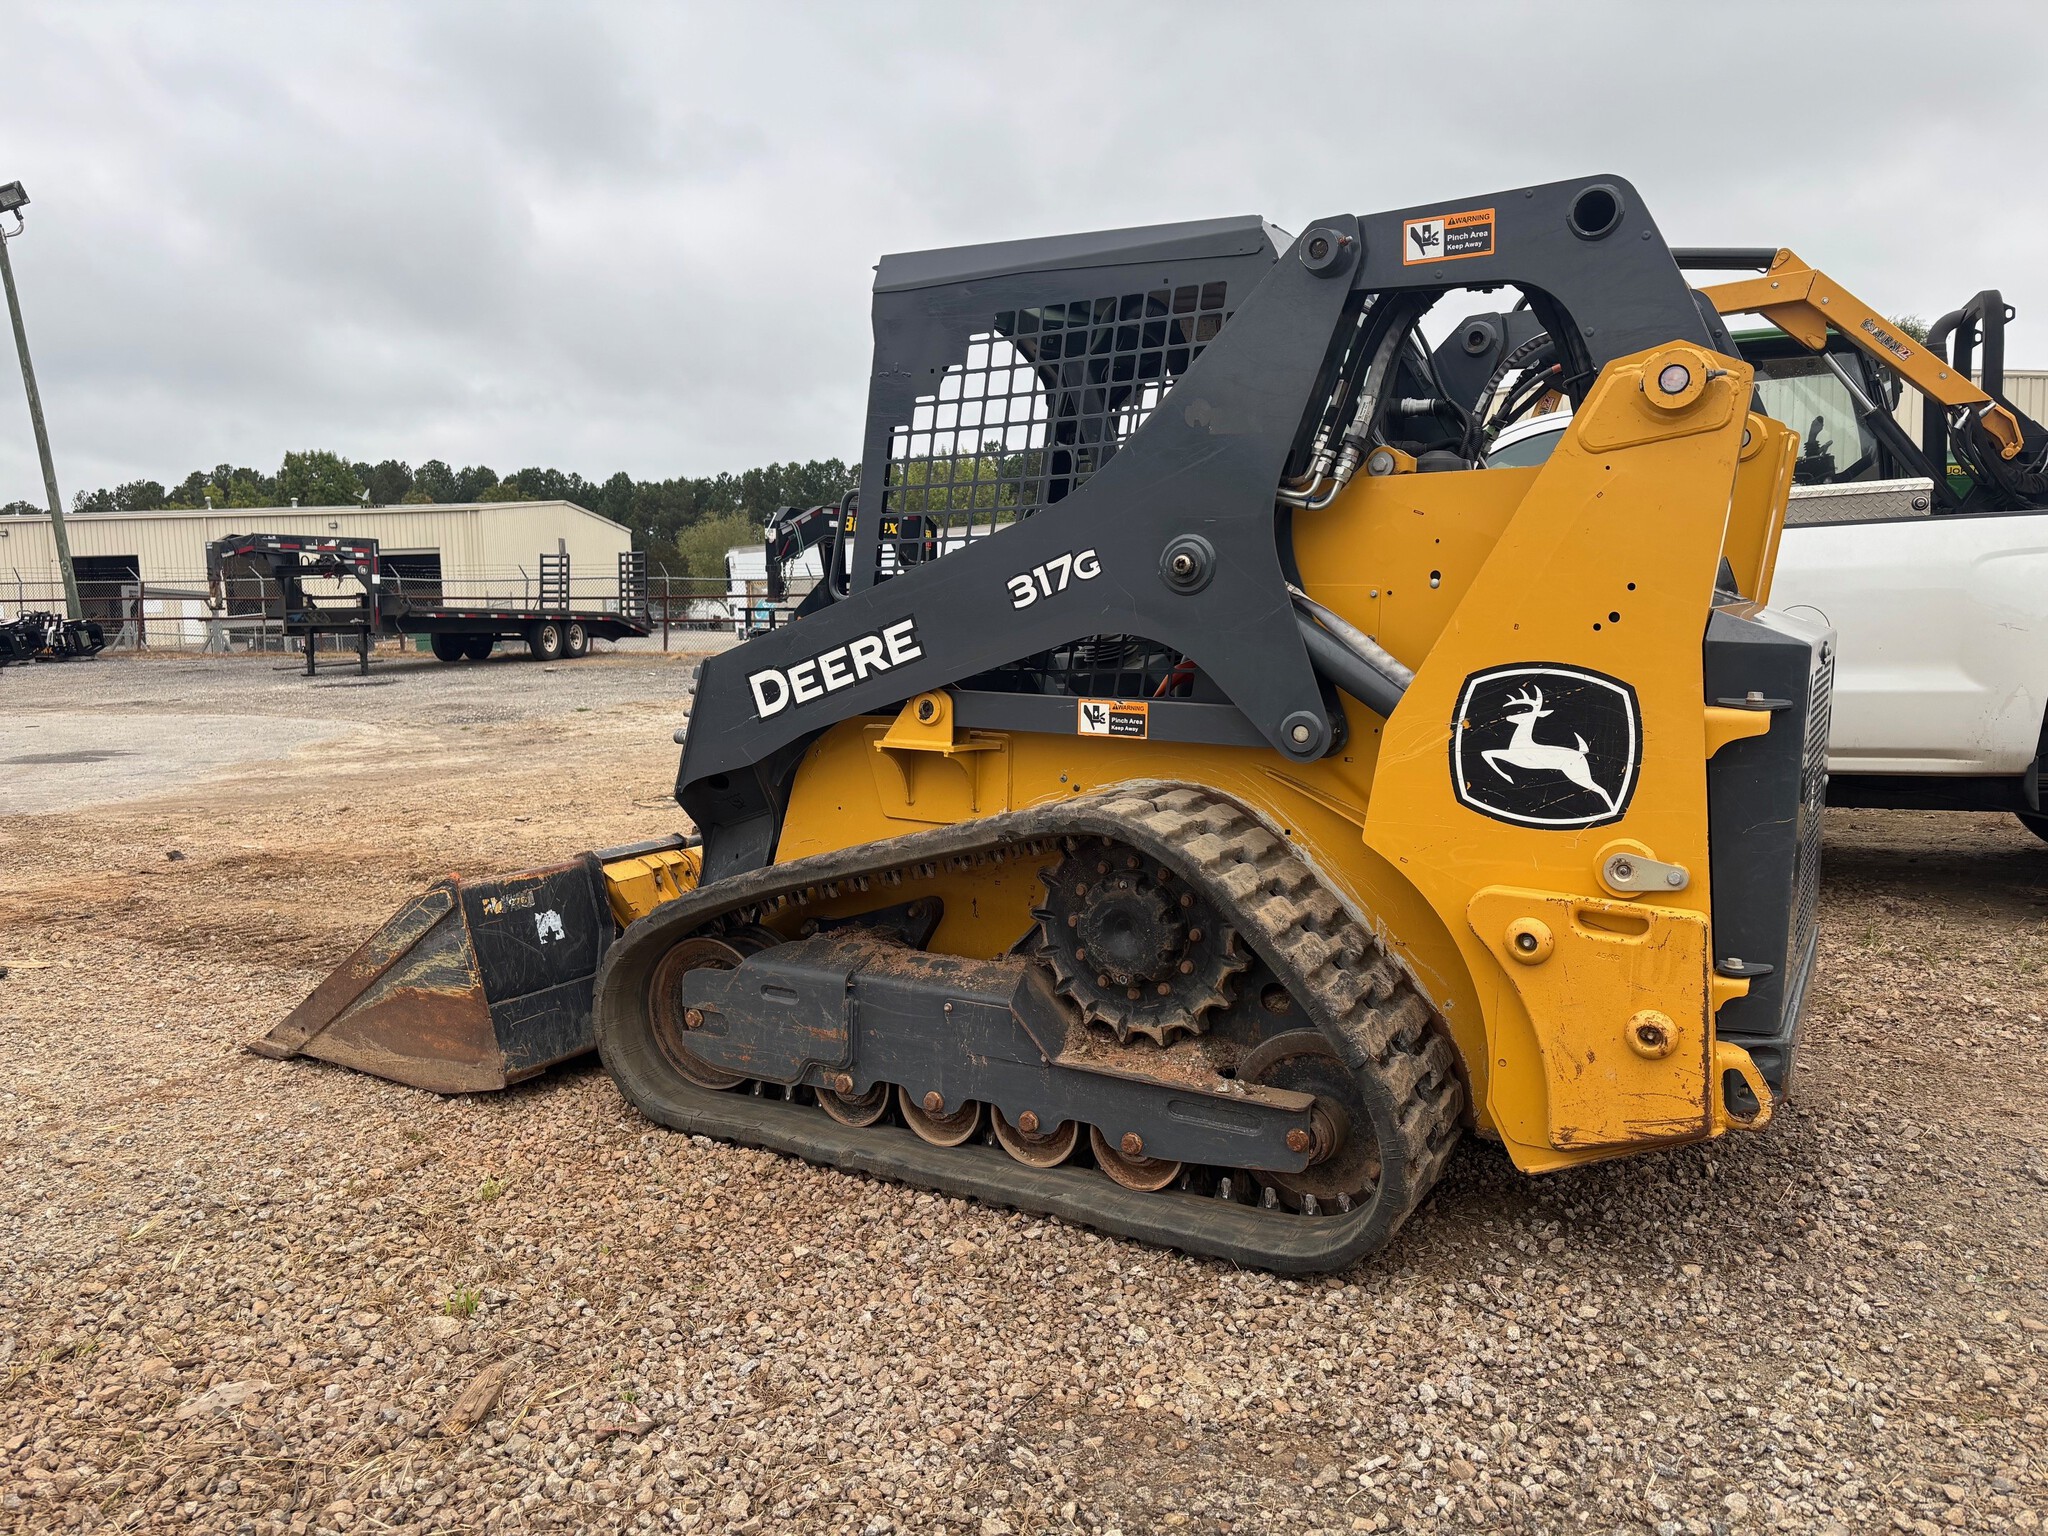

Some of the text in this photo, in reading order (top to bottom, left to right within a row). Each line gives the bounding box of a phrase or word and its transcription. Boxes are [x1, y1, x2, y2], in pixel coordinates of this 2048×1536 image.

[1455, 213, 1490, 224] WARNING
[1447, 230, 1489, 242] Pinch Area
[1447, 241, 1482, 251] Keep Away
[1007, 549, 1101, 609] 317G
[749, 619, 922, 719] DEERE
[1117, 704, 1145, 712] WARNING
